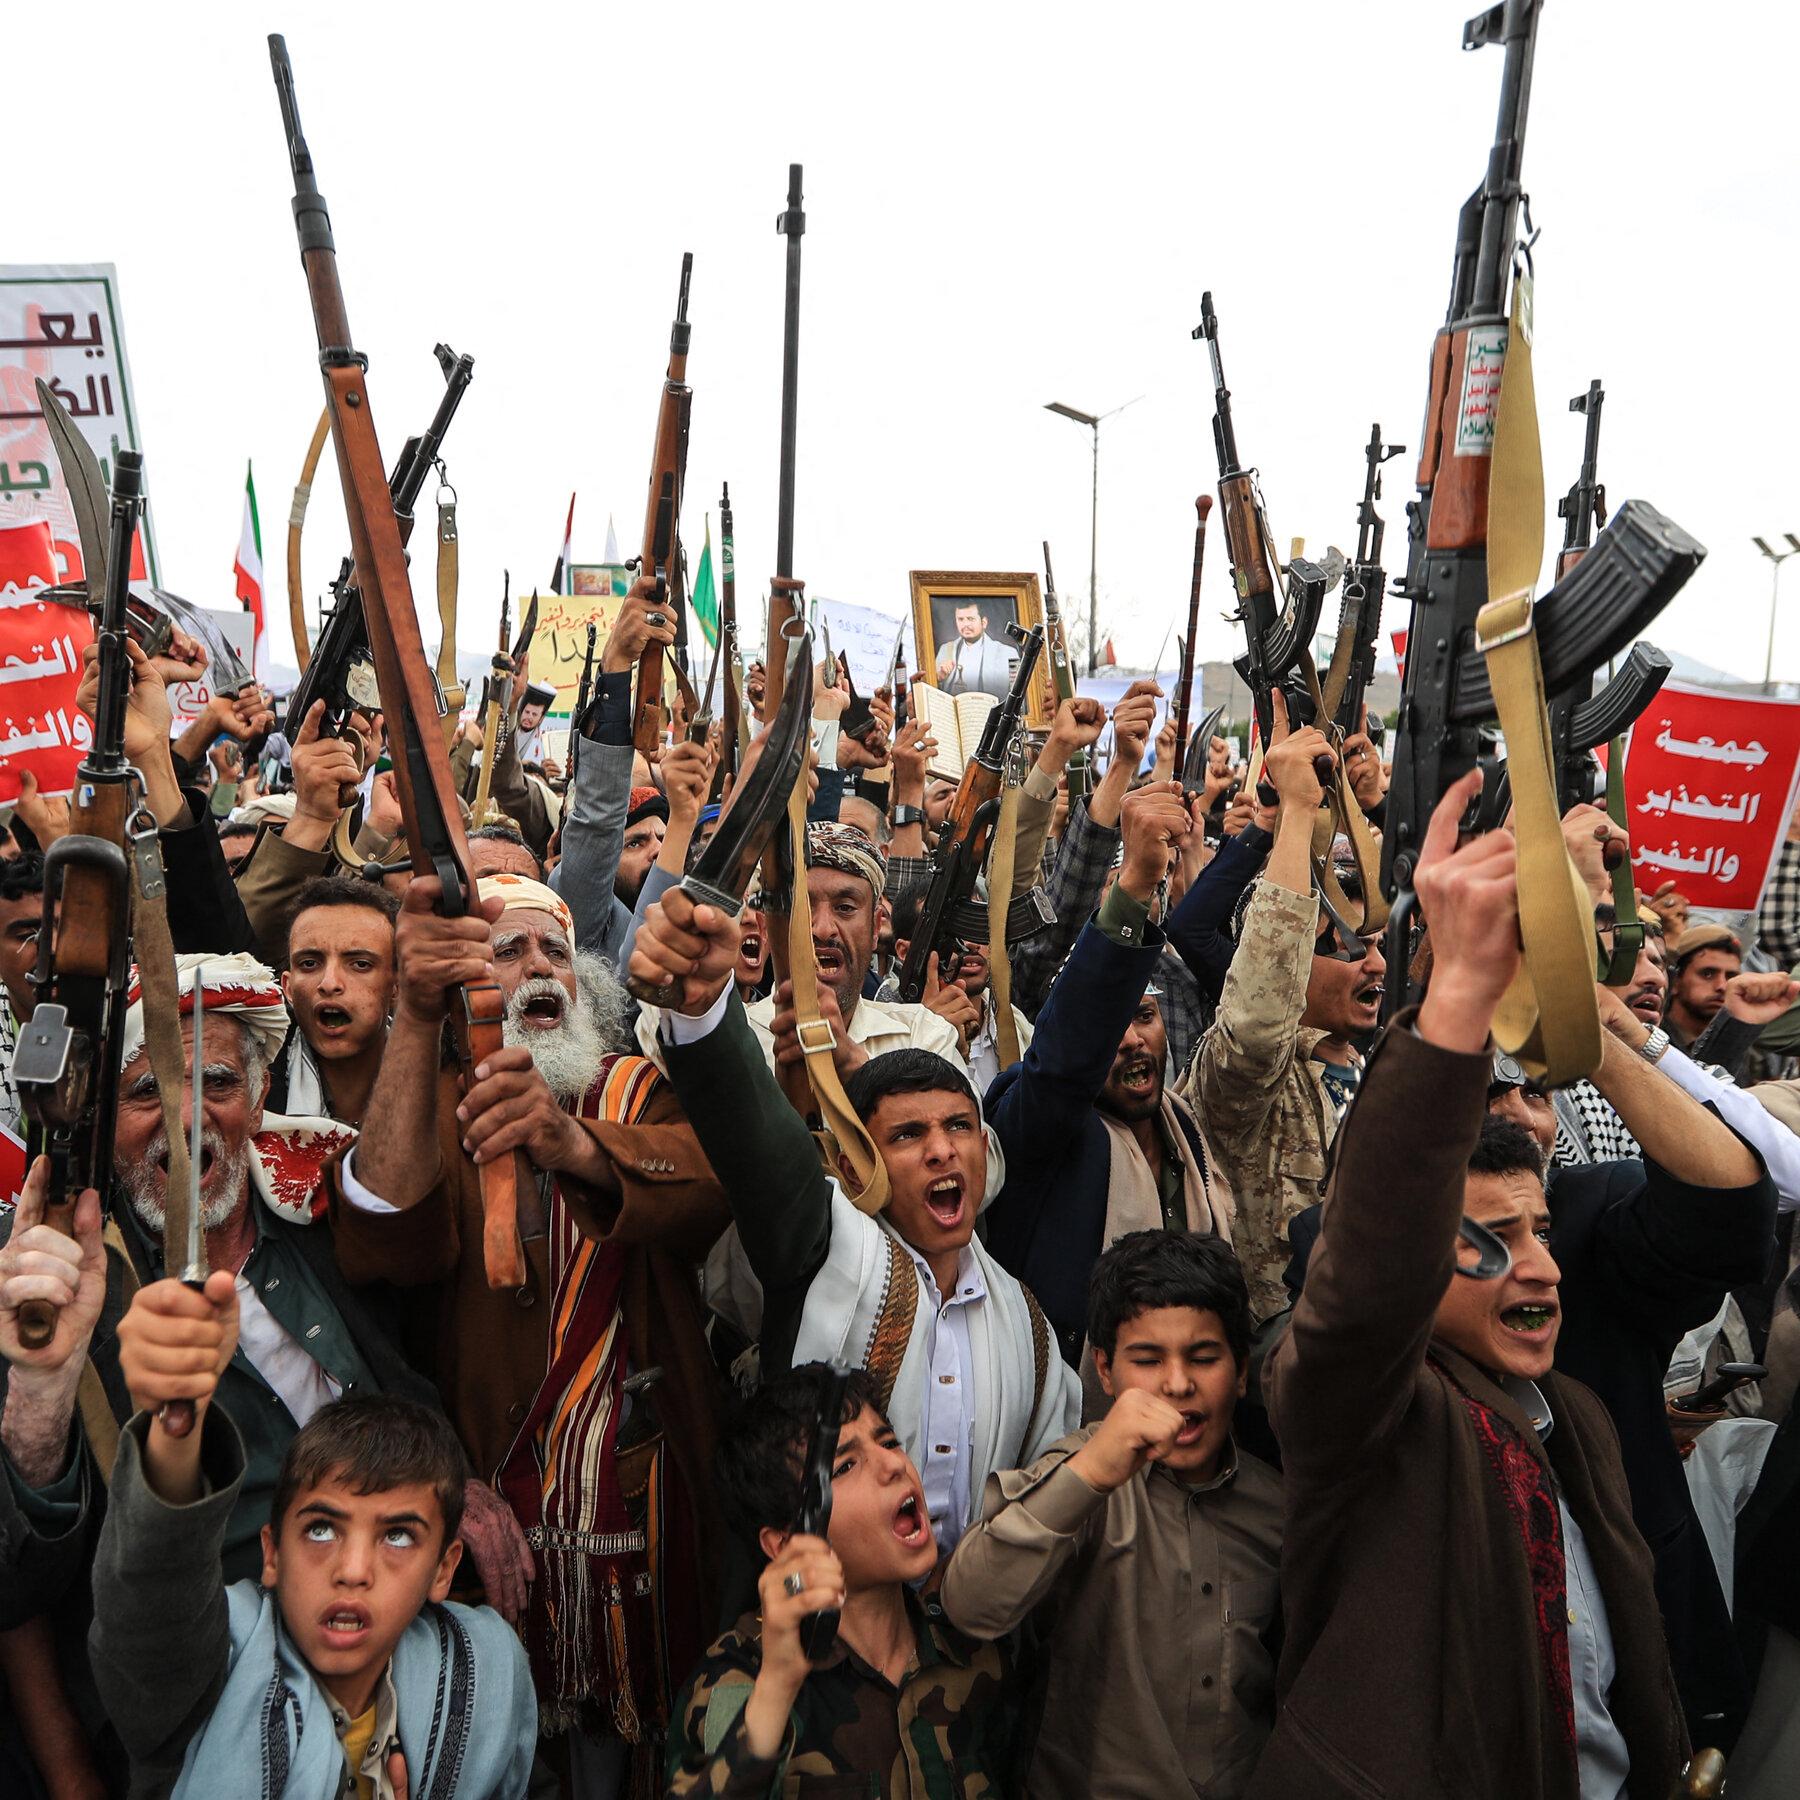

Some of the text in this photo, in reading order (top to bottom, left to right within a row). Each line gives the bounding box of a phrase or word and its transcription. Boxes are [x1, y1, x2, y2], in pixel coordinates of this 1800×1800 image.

[1654, 718, 1770, 773] جمعة
[1636, 784, 1762, 824] التحذير
[1630, 839, 1741, 883] والنفير
